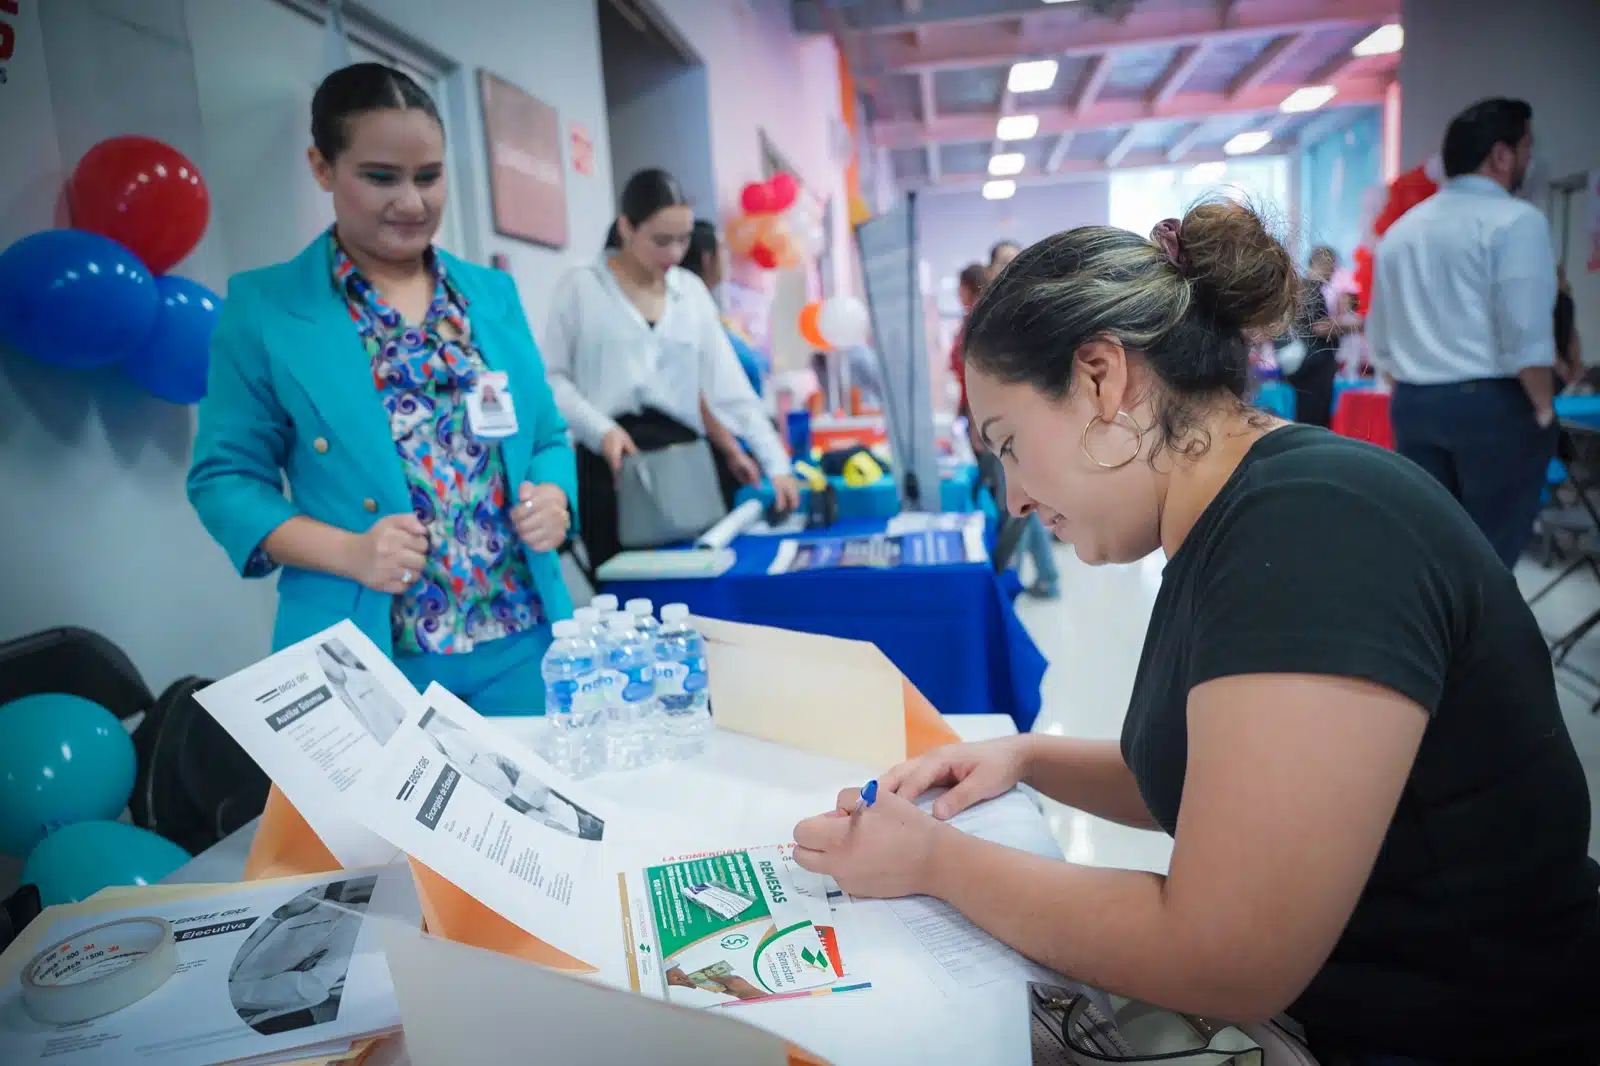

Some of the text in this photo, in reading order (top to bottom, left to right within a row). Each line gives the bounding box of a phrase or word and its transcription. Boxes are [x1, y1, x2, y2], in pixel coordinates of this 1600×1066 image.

[408, 756, 430, 785] EAGLE GAS
[425, 794, 445, 821] Encargado
[441, 770, 457, 791] Estación
[759, 861, 787, 904] REMESAS
[181, 922, 247, 940] Ejecutiva
[54, 961, 81, 980] Scotch
[89, 950, 105, 961] 500
[66, 950, 80, 961] 500
[775, 951, 796, 984] Bienestar
[786, 943, 803, 974] Financiera
